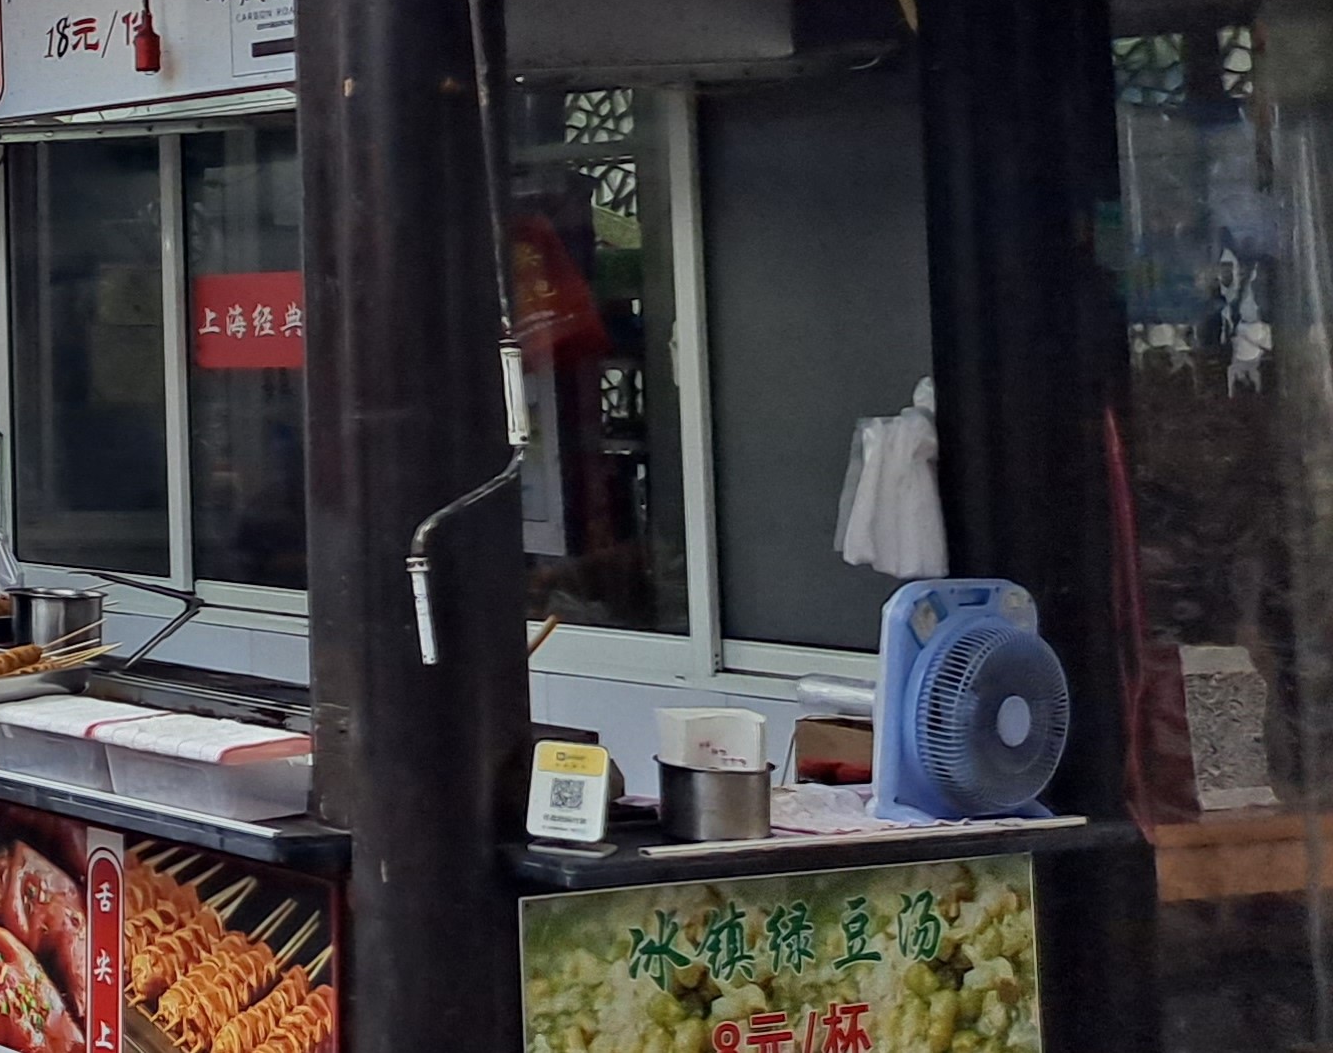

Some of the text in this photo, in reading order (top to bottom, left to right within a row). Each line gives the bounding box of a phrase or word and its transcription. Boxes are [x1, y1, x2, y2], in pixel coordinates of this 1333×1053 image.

[197, 300, 304, 339] 上海经典
[93, 881, 115, 1050] 舌尖上
[627, 889, 943, 992] 冰镇绿豆汤
[712, 1002, 873, 1053] 8元/杯
